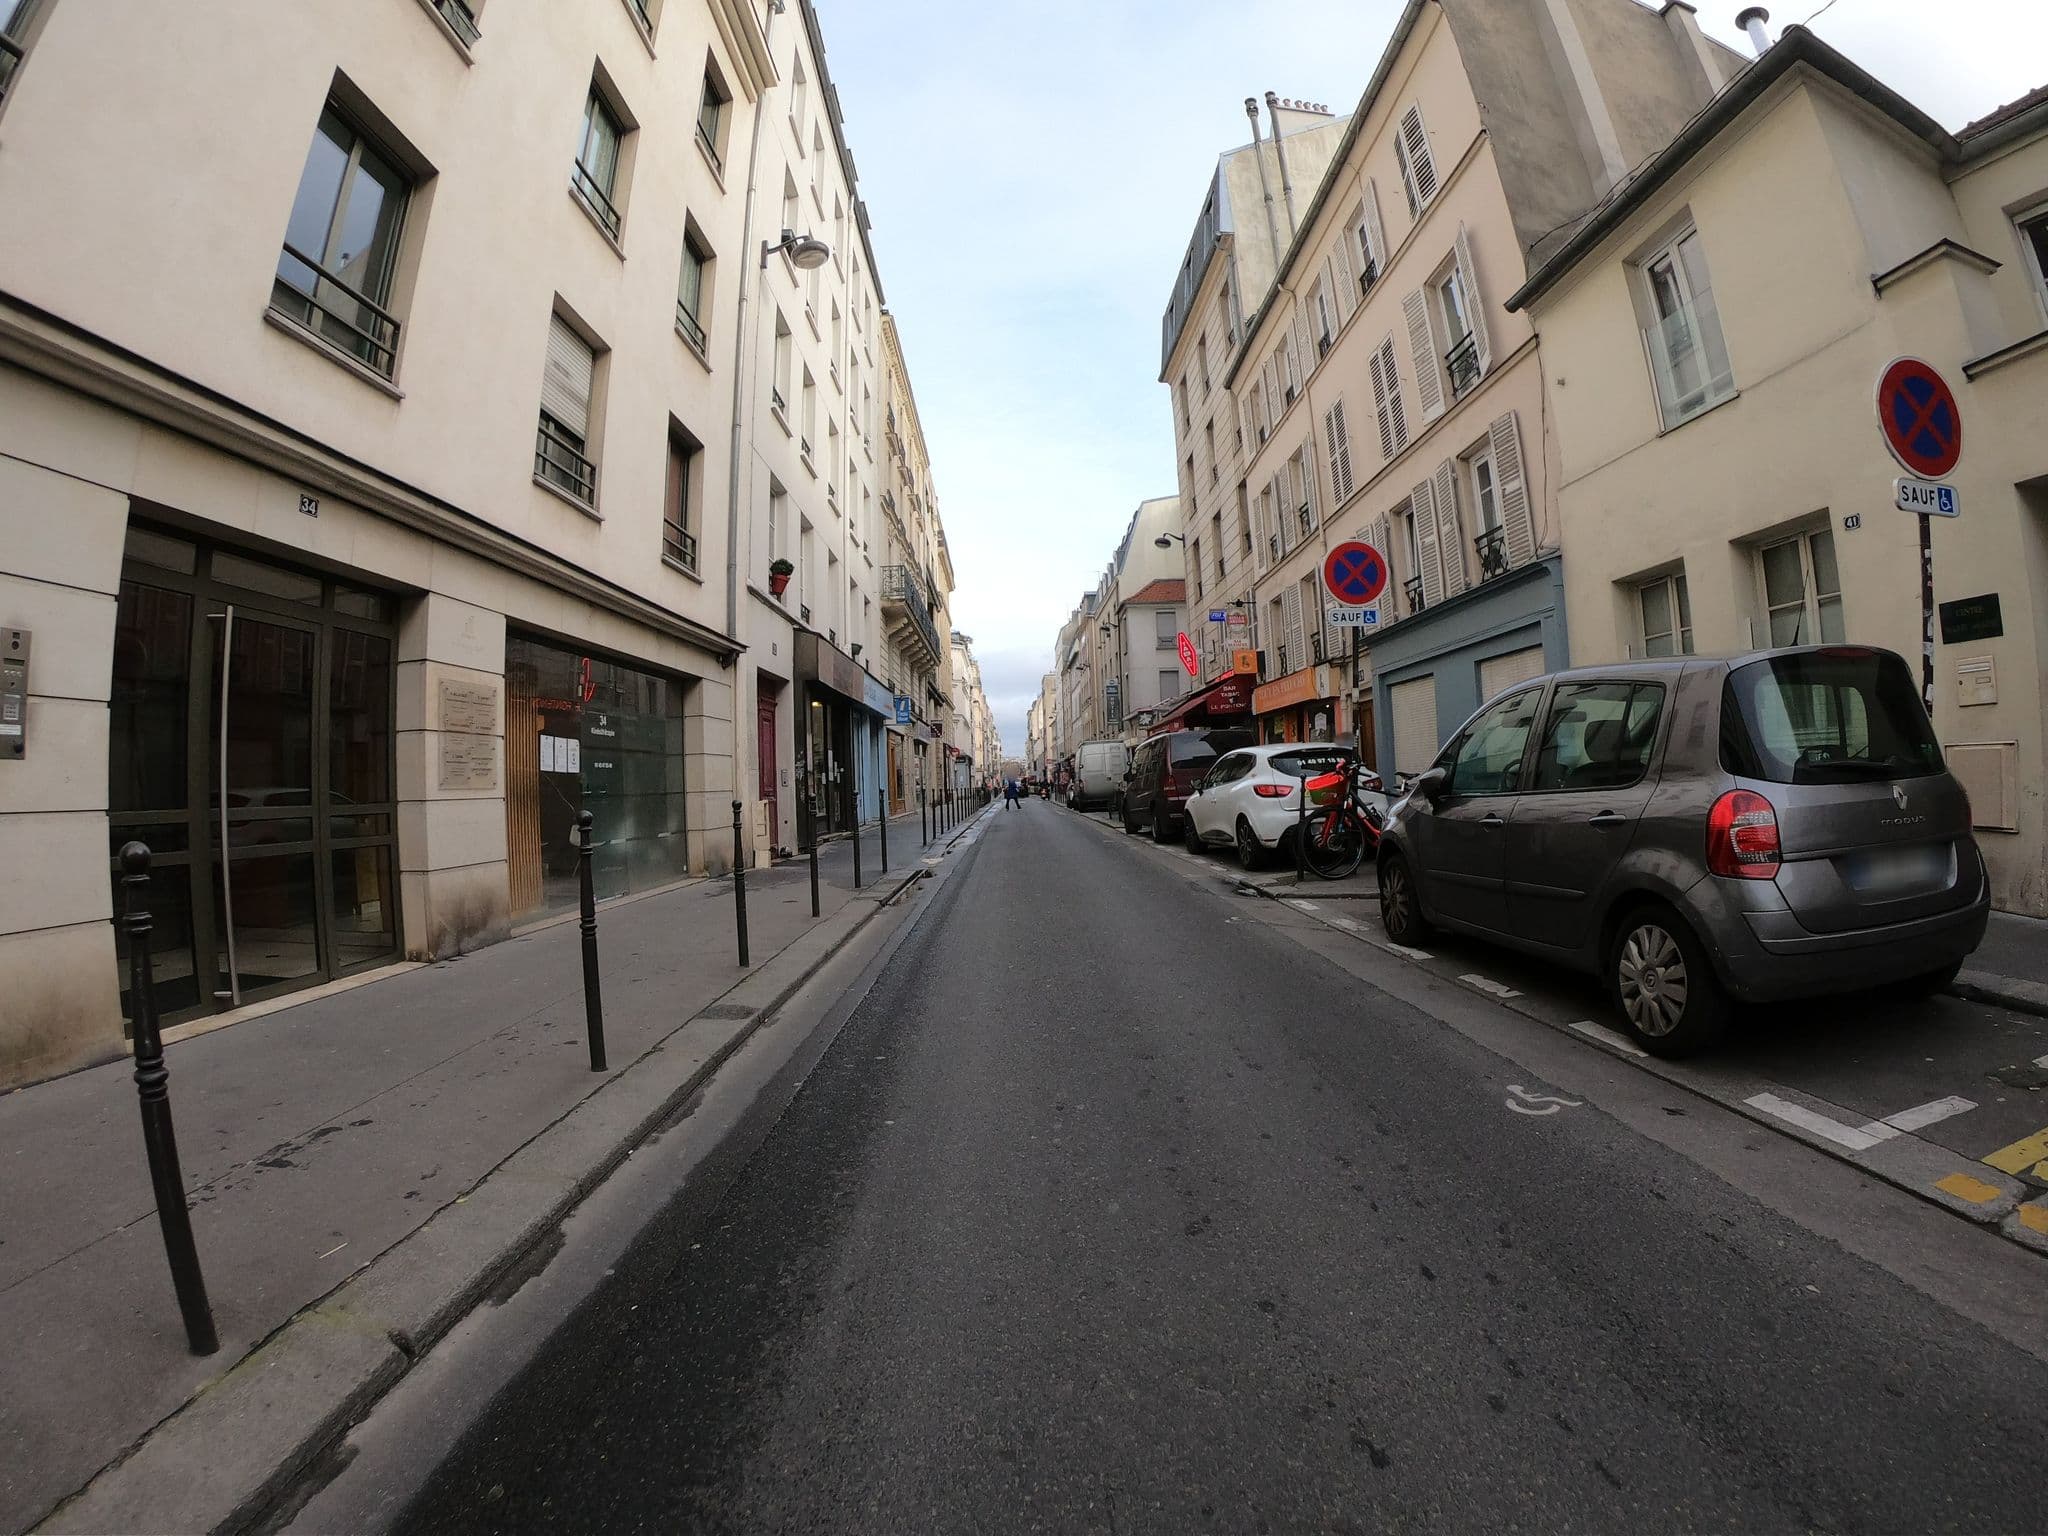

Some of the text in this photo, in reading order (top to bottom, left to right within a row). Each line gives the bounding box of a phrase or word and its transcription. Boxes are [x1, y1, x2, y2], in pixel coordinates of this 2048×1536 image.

[1901, 485, 1935, 506] SAUF
[302, 498, 316, 514] 34
[1846, 517, 1858, 528] 41
[1332, 612, 1361, 622] SAUF
